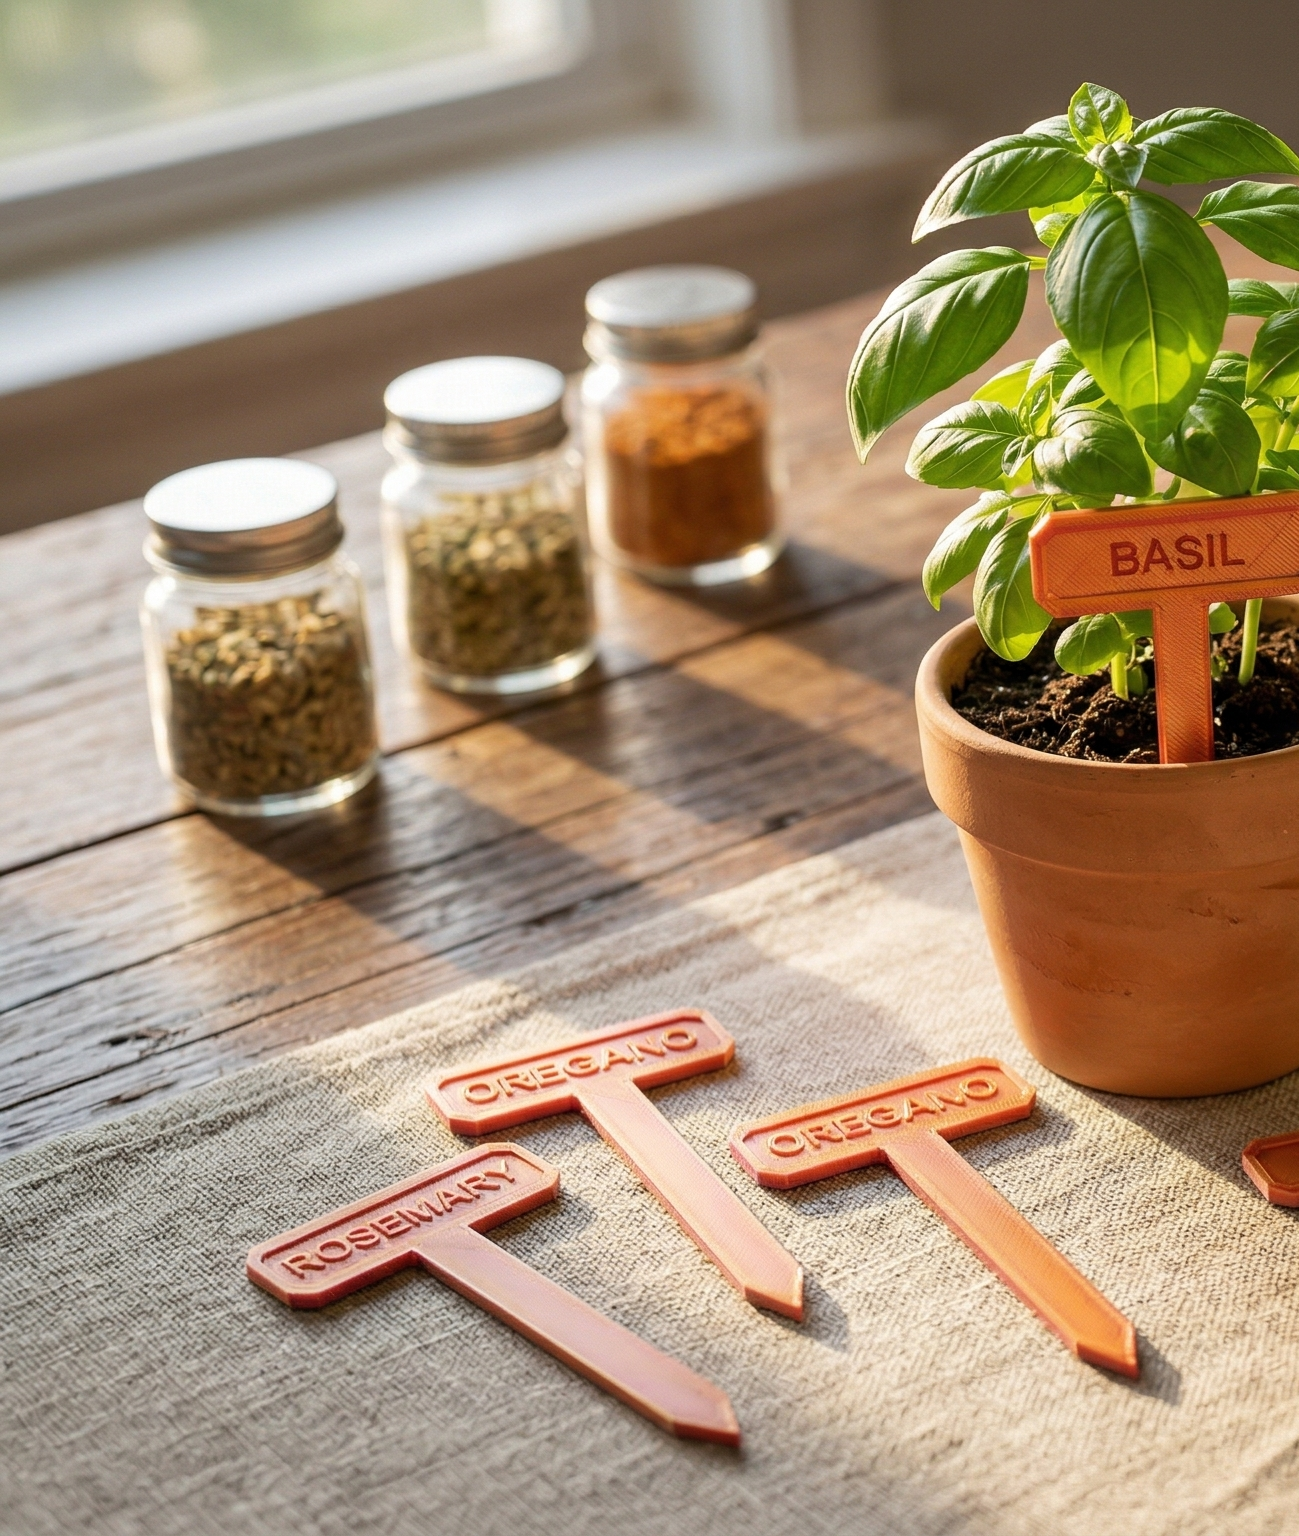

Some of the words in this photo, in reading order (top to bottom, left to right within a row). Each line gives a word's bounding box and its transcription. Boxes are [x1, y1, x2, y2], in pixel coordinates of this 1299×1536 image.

[1110, 531, 1245, 577] BASIL
[463, 1028, 697, 1104] OREGANO
[767, 1078, 998, 1157] OREGANO
[281, 1160, 516, 1280] ROSEMARY
